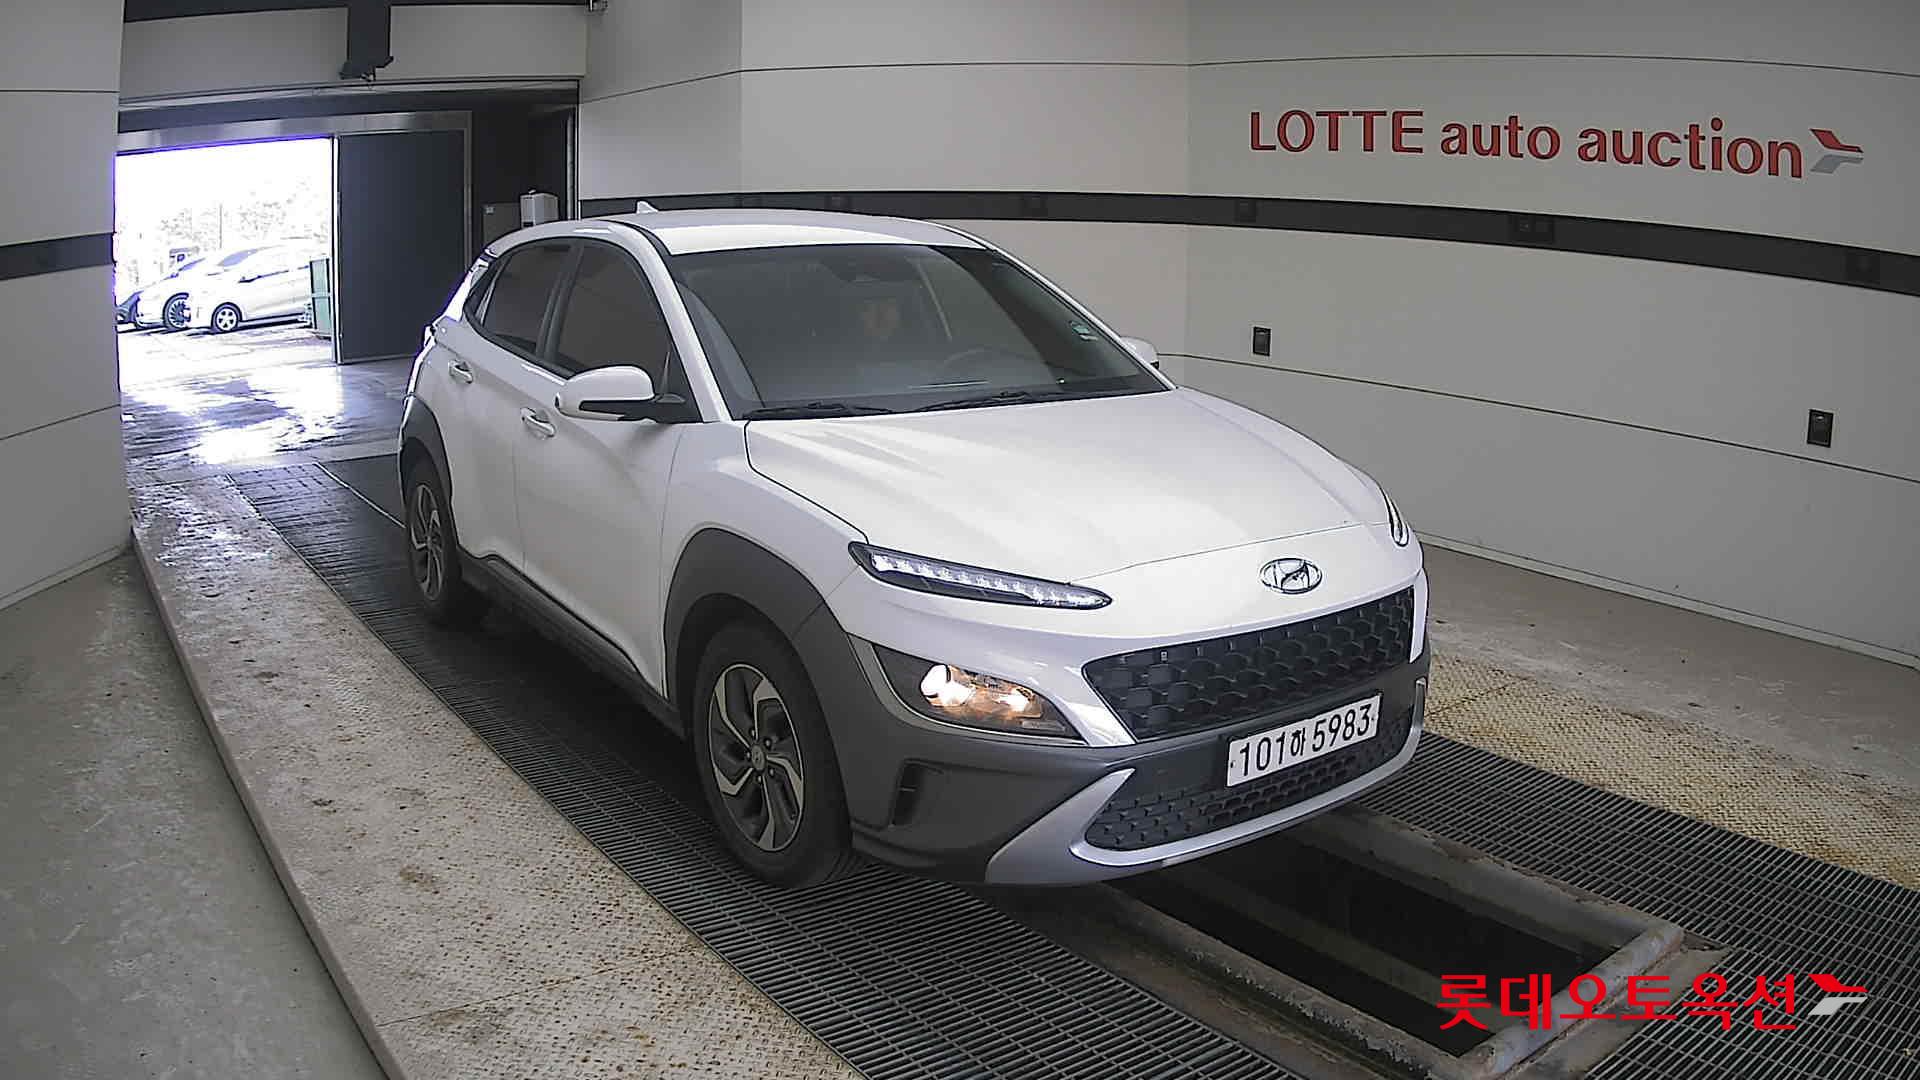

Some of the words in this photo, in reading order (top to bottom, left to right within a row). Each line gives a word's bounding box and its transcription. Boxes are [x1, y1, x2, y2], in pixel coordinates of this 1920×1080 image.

[1249, 110, 1424, 154] LOTTE
[1440, 115, 1561, 160] auto
[1577, 117, 1803, 179] auction
[1238, 728, 1307, 777] 101하
[1312, 703, 1372, 753] 5983
